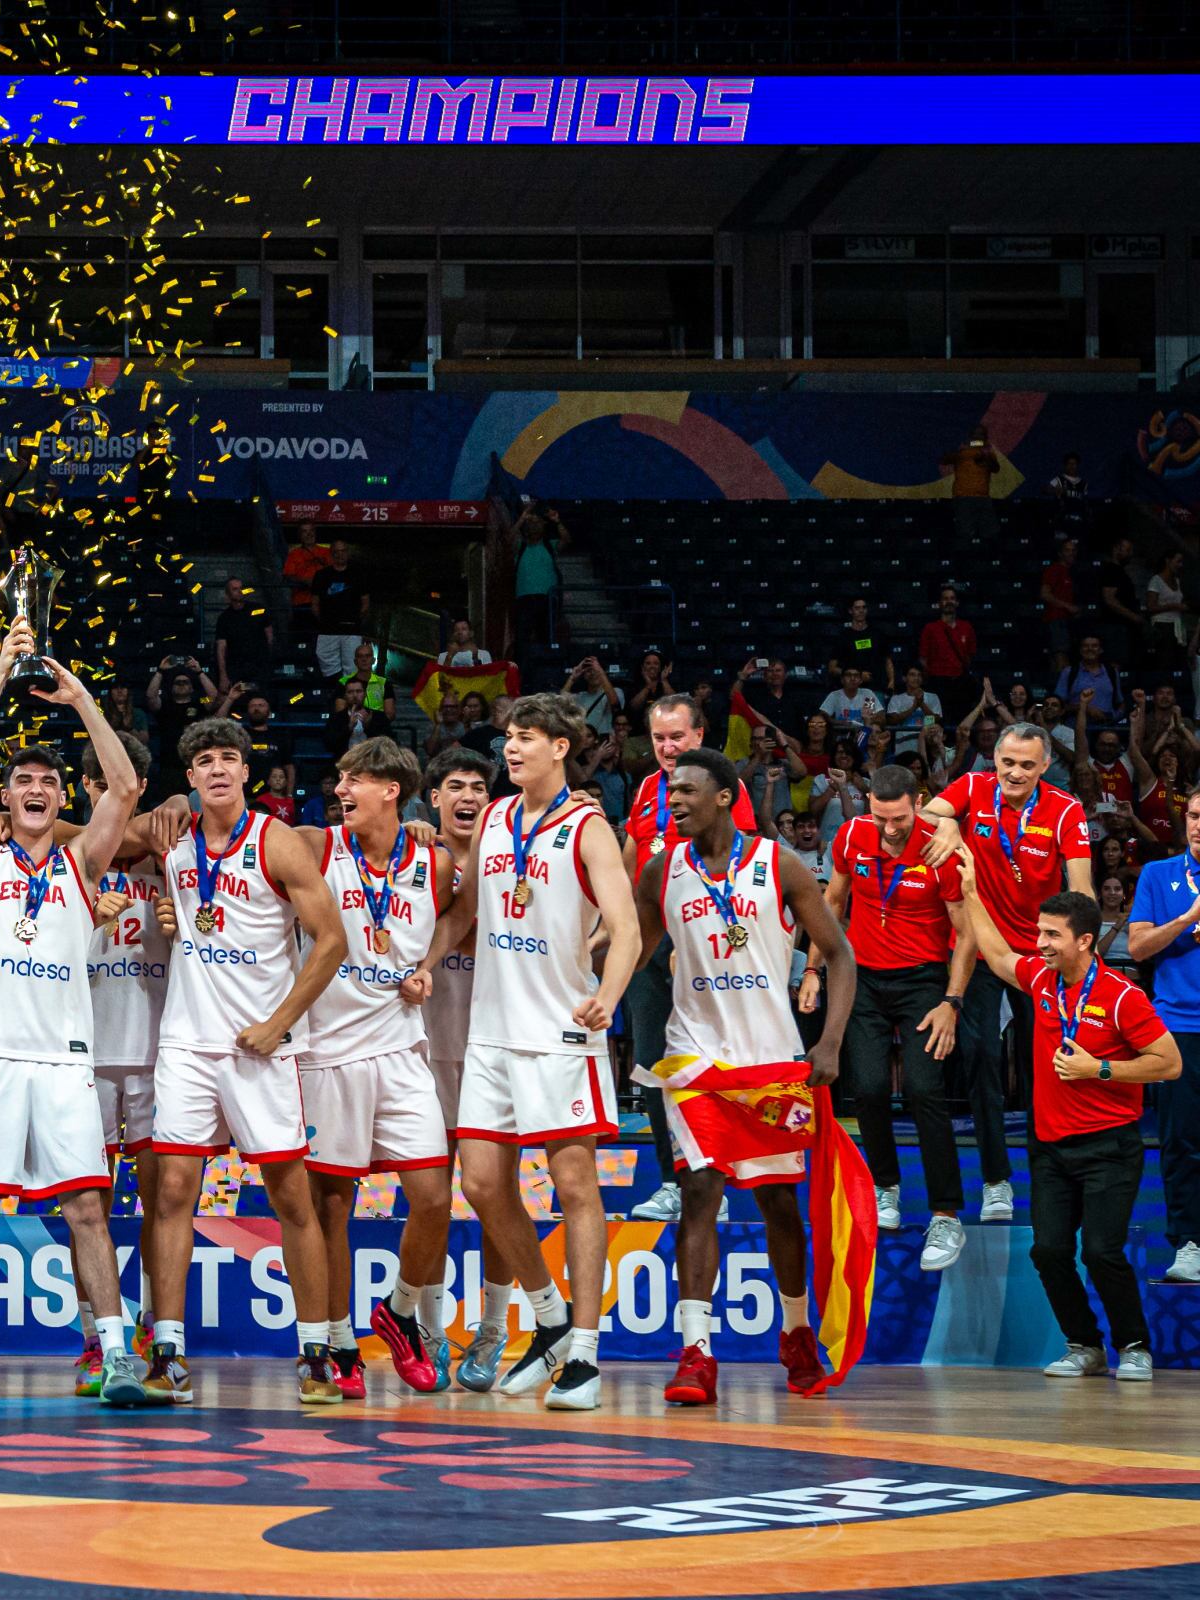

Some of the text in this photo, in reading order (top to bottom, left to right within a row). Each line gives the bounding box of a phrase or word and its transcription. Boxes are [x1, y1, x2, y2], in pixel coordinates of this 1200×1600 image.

[227, 78, 755, 143] CHAMPIONS
[262, 402, 324, 413] PRESENTED BY
[215, 437, 369, 461] VODAVODA
[291, 504, 321, 513] DESNO
[362, 507, 390, 521] 215
[438, 504, 461, 513] LEVO
[681, 893, 758, 924] ESPÑA
[112, 917, 142, 946] 12
[182, 940, 257, 965] edesa
[86, 957, 166, 978] endesa
[692, 971, 769, 992] endesa
[540, 1477, 1032, 1534] 2025
